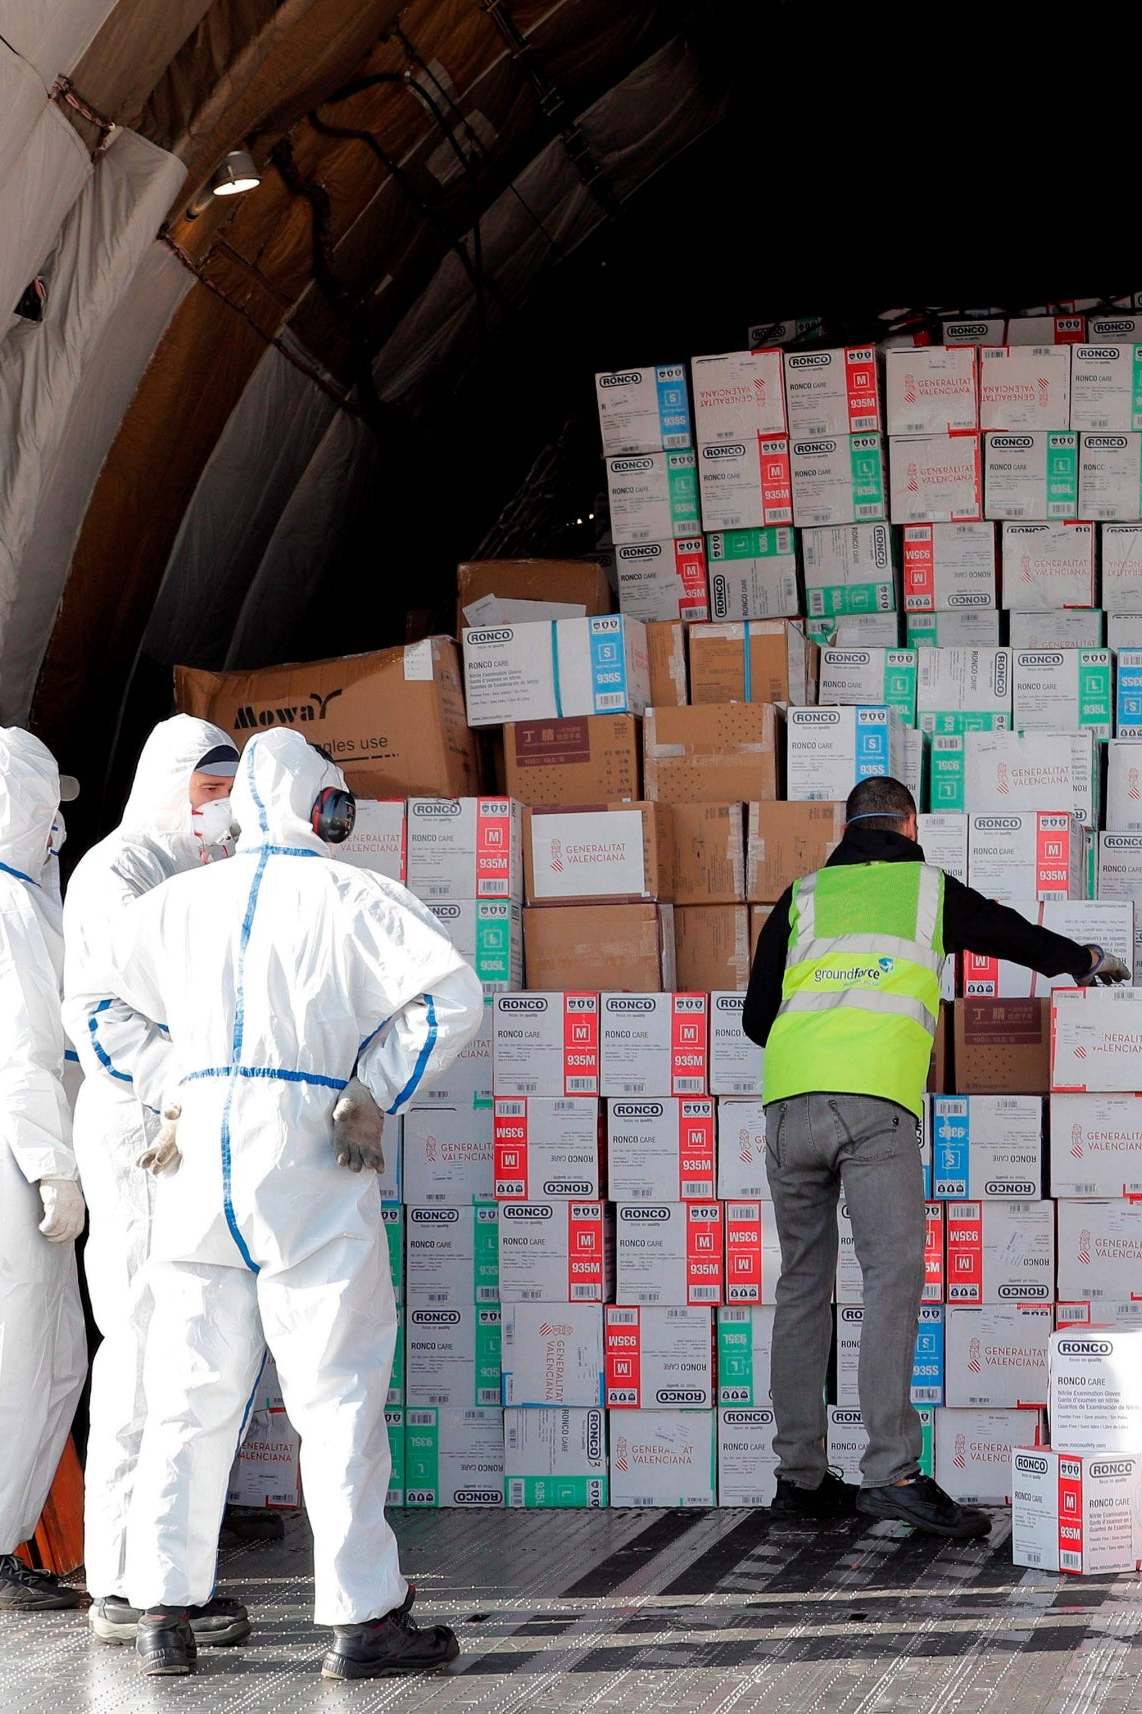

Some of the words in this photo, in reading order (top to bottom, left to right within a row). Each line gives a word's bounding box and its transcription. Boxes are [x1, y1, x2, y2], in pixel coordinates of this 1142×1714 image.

[1097, 321, 1132, 333] RONCO
[1080, 349, 1117, 358] RONCO
[792, 355, 829, 366] RONCO
[601, 376, 639, 385] RONCO
[917, 377, 972, 389] GENERALITAT
[919, 385, 971, 396] VALENCIANA
[850, 398, 875, 409] 935M
[994, 437, 1031, 447] RONCO
[1087, 437, 1125, 447] RONCO
[706, 447, 743, 456] RONCO
[797, 443, 833, 453] RONCO
[614, 461, 650, 470] RONCO
[920, 464, 974, 476] GENERALITAT
[921, 473, 974, 484] VALENCIANA
[765, 489, 789, 500] 935M
[622, 547, 659, 557] RONCO
[876, 530, 885, 565] RONCO
[906, 548, 930, 559] 935M
[715, 578, 724, 615] RONCO
[951, 595, 988, 605] RONCO
[470, 631, 511, 642] RONCO
[603, 647, 611, 657] S
[828, 653, 867, 663] RONCO
[1021, 655, 1060, 665] RONCO
[468, 660, 493, 669] RONCO
[596, 671, 621, 684] 935S
[997, 655, 1006, 693] RONCO
[796, 713, 837, 723] RONCO
[360, 736, 388, 750] use
[860, 763, 885, 775] 935S
[1011, 766, 1070, 778] GENERALITAT
[1012, 775, 1070, 786] VALENCIANA
[416, 804, 458, 814] RONCO
[977, 819, 1018, 828] RONCO
[341, 844, 399, 853] VALENCIANA
[566, 843, 626, 854] GENERALITAT
[1048, 845, 1059, 855] M
[479, 857, 508, 869] 935M
[567, 852, 626, 864] VALENCIANA
[1039, 870, 1067, 881] 935M
[814, 967, 880, 983] groundforce
[502, 1000, 544, 1010] RONCO
[609, 1000, 652, 1010] RONCO
[497, 1030, 523, 1039] RONCO
[524, 1030, 541, 1039] CARE
[575, 1027, 587, 1038] M
[567, 1055, 596, 1066] 935M
[674, 1055, 703, 1067] 935M
[617, 1105, 660, 1115] RONCO
[496, 1127, 524, 1138] 935M
[682, 1159, 711, 1171] 935M
[546, 1183, 589, 1193] RONCO
[989, 1183, 1032, 1193] RONCO
[414, 1211, 456, 1221] RONCO
[507, 1206, 550, 1217] RONCO
[624, 1208, 667, 1219] RONCO
[950, 1230, 978, 1241] 935M
[571, 1262, 600, 1274] 935M
[690, 1264, 719, 1276] 935M
[1001, 1286, 1045, 1297] RONCO
[416, 1312, 457, 1323] RONCO
[609, 1335, 637, 1346] 935M
[984, 1346, 1047, 1357] GENERALITAT
[1062, 1343, 1109, 1353] RONCO
[985, 1355, 1046, 1367] VALENCIANA
[545, 1340, 555, 1400] VALENCIANA
[555, 1339, 565, 1402] GENERALITAT
[1057, 1376, 1087, 1386] RONCO
[1087, 1378, 1106, 1386] CARE
[659, 1391, 703, 1402] RONCO
[727, 1412, 770, 1422] RONCO
[588, 1413, 599, 1456] RONCO
[1017, 1459, 1046, 1472] RONCO
[1093, 1462, 1133, 1475] RONCO
[1089, 1498, 1114, 1508] RONCO
[1114, 1498, 1130, 1506] CARE
[1060, 1526, 1081, 1541] 935M
